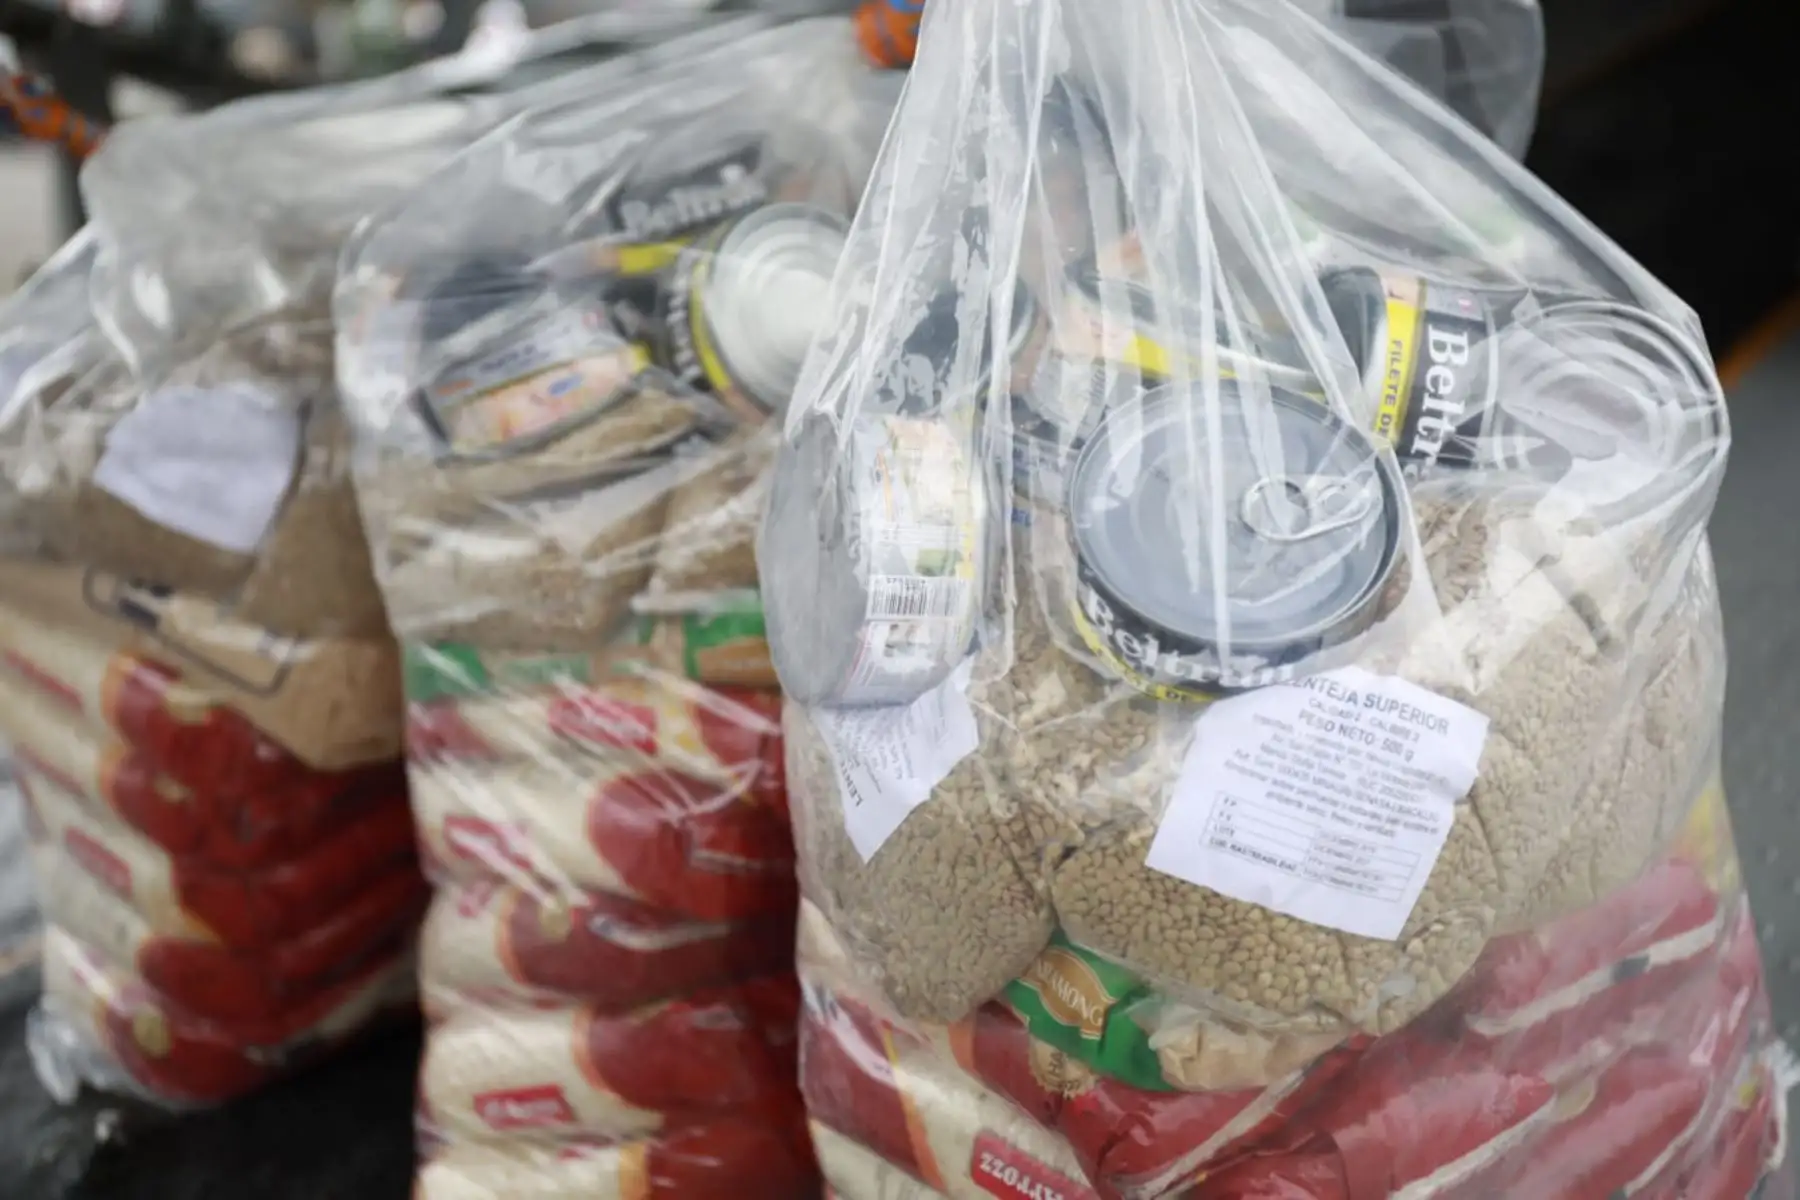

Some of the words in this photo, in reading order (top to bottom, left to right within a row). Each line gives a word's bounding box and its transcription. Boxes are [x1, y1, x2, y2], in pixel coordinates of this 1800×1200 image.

[1382, 339, 1404, 408] FILETE
[1299, 709, 1335, 732] PESO
[1362, 693, 1449, 735] SUPERIOR
